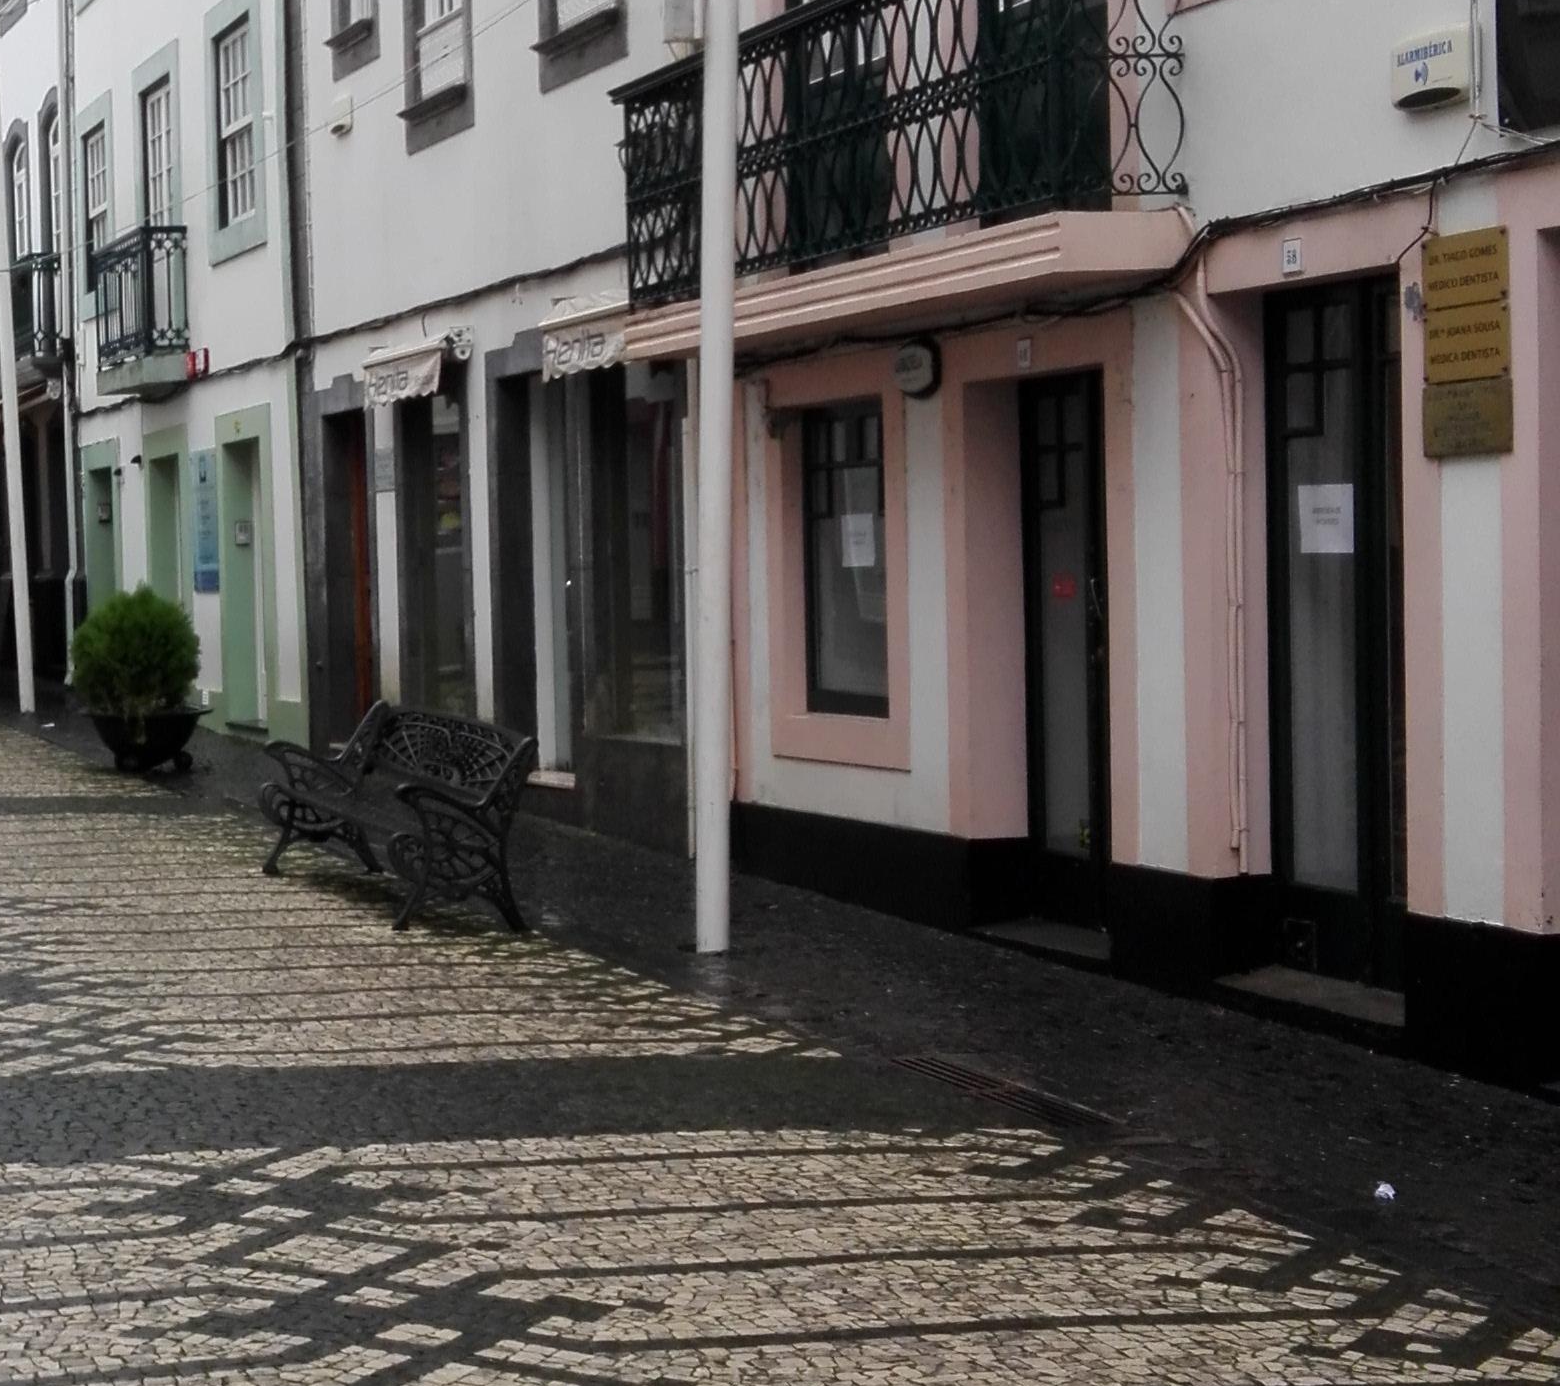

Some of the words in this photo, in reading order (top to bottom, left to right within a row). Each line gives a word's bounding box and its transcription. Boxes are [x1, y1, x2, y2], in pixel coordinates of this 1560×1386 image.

[1442, 249, 1468, 262] TIAGO
[1469, 244, 1498, 258] GOMES
[1459, 271, 1499, 287] DENTISTA
[1472, 320, 1501, 334] SOUSA
[1460, 347, 1500, 362] DENTISTA
